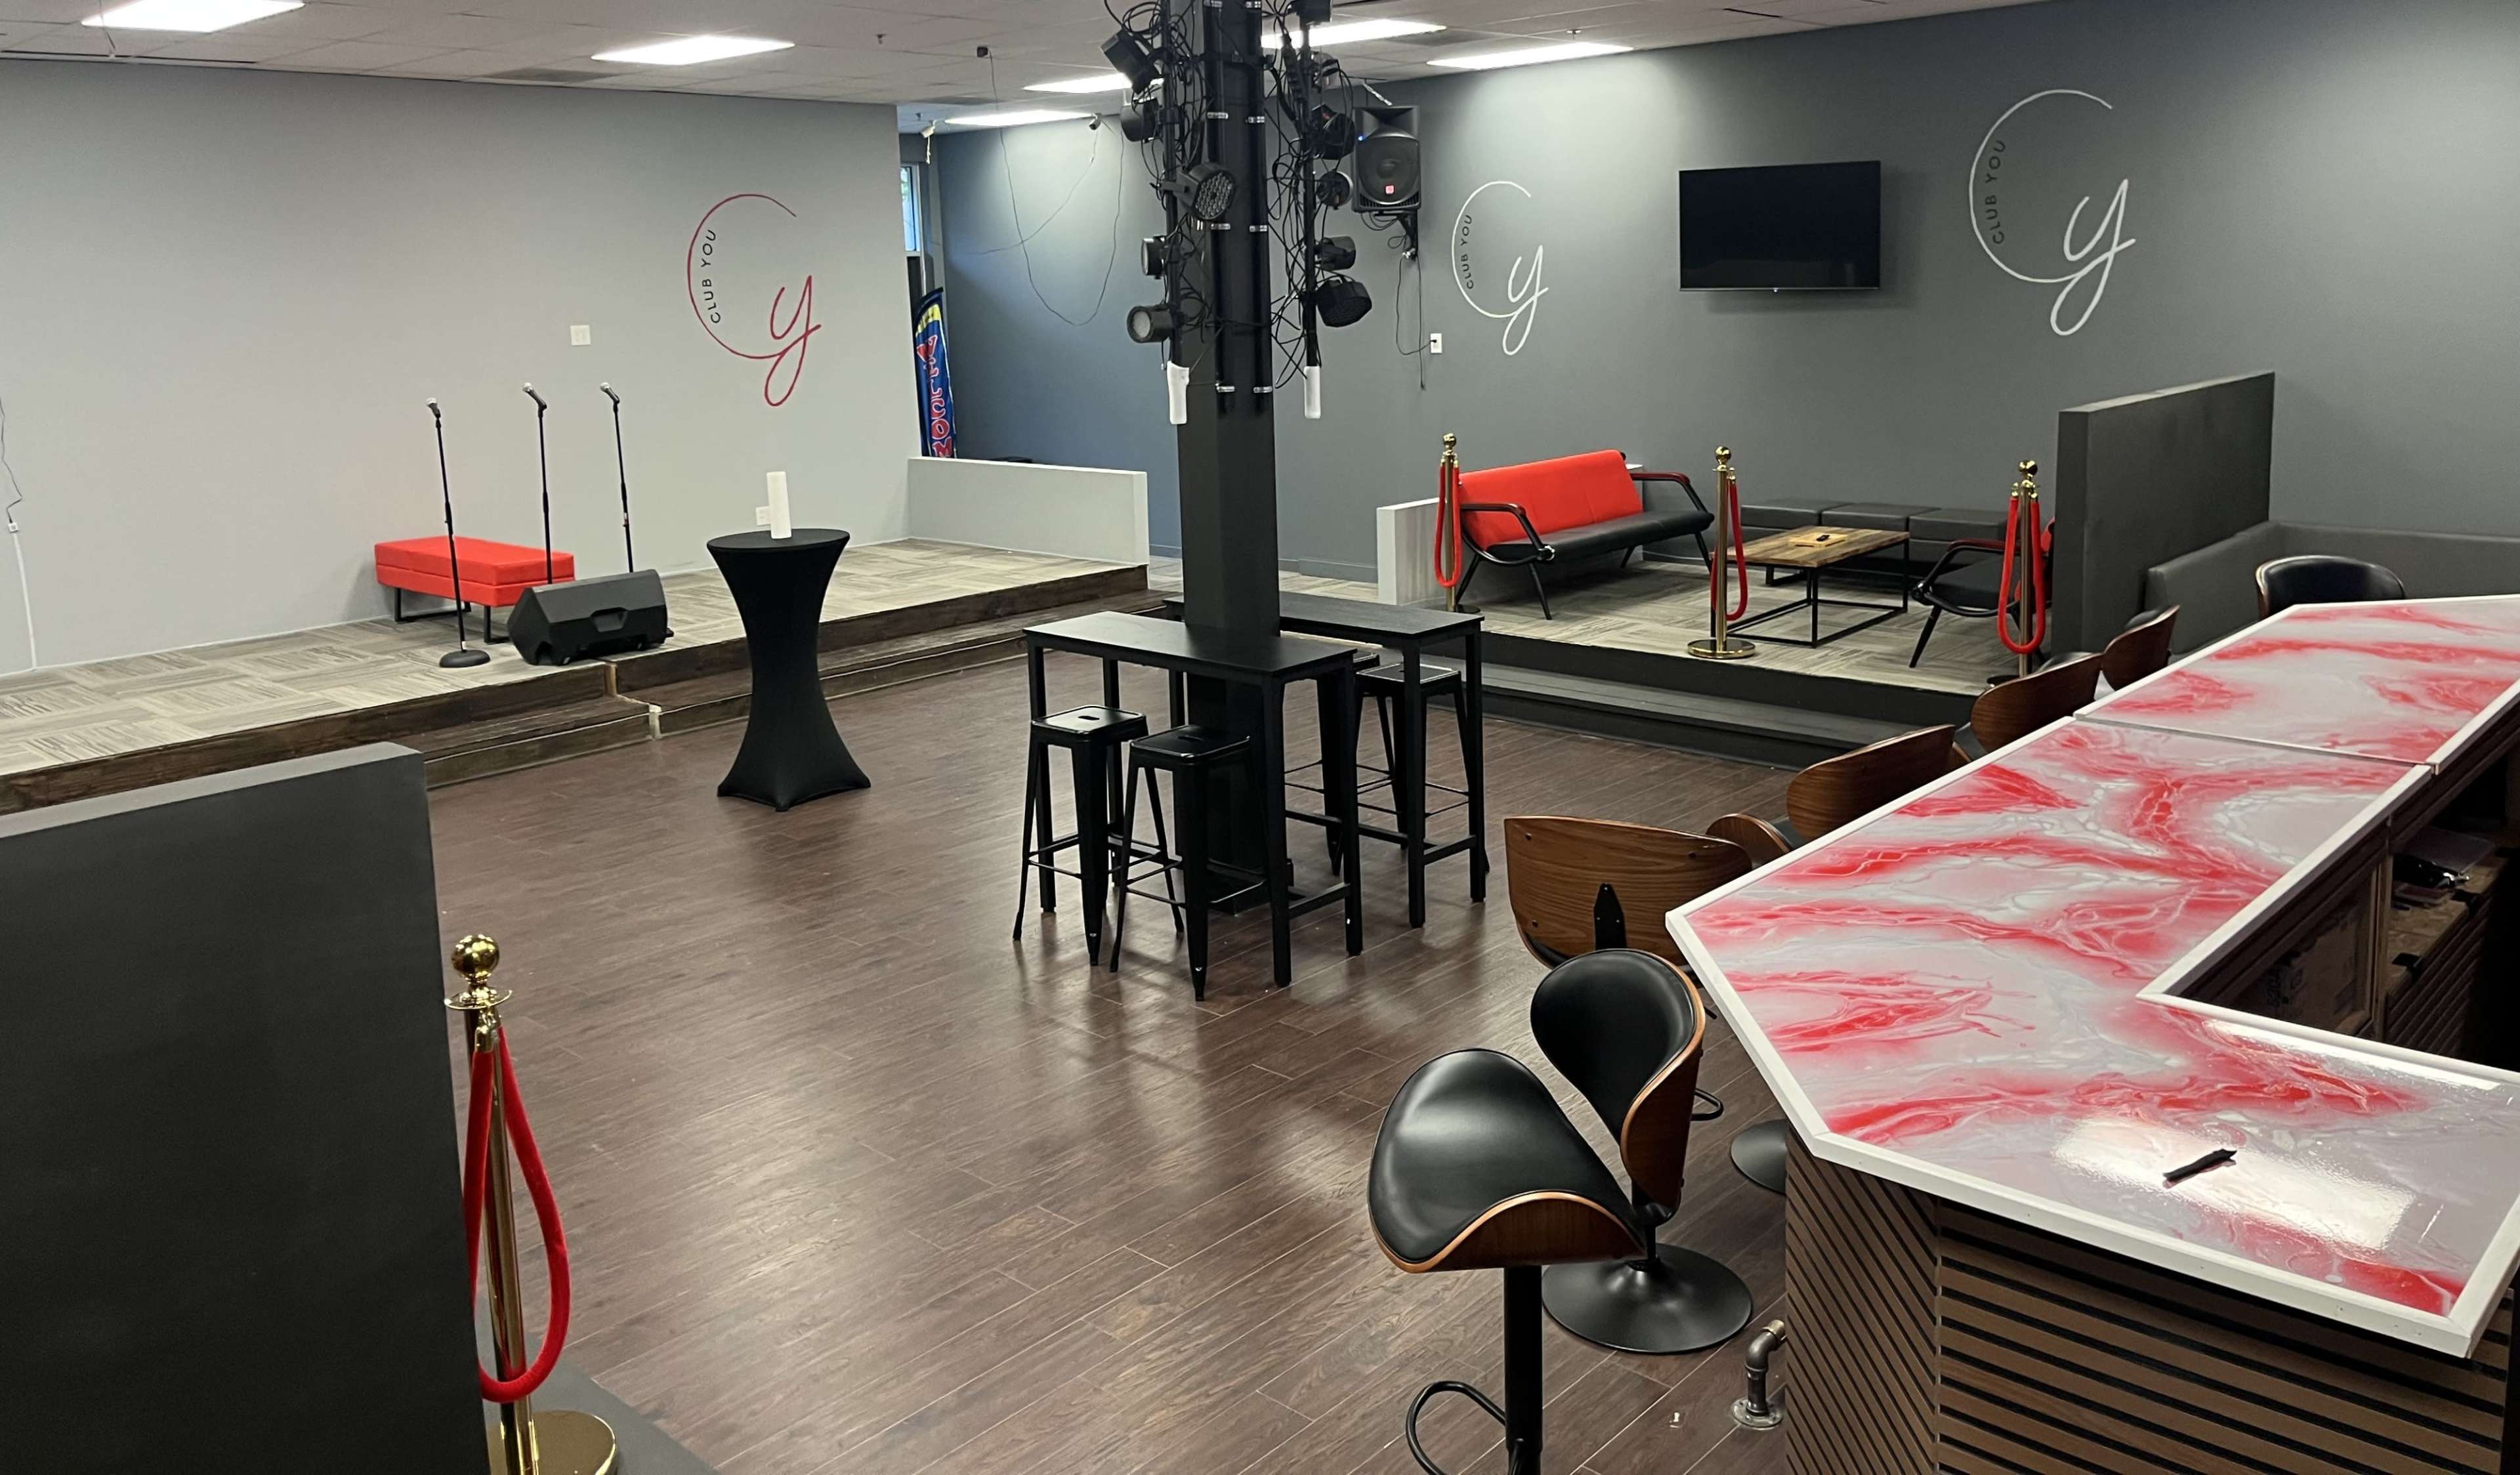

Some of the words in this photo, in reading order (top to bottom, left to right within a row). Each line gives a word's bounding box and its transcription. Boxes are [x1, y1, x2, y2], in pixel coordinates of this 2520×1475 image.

[1985, 139, 2006, 184] YOU
[1460, 215, 1473, 247] YOU
[1984, 194, 2005, 245] CLUB
[700, 229, 717, 268] YOU
[1461, 253, 1474, 289] CLUB
[702, 278, 721, 323] CLUB
